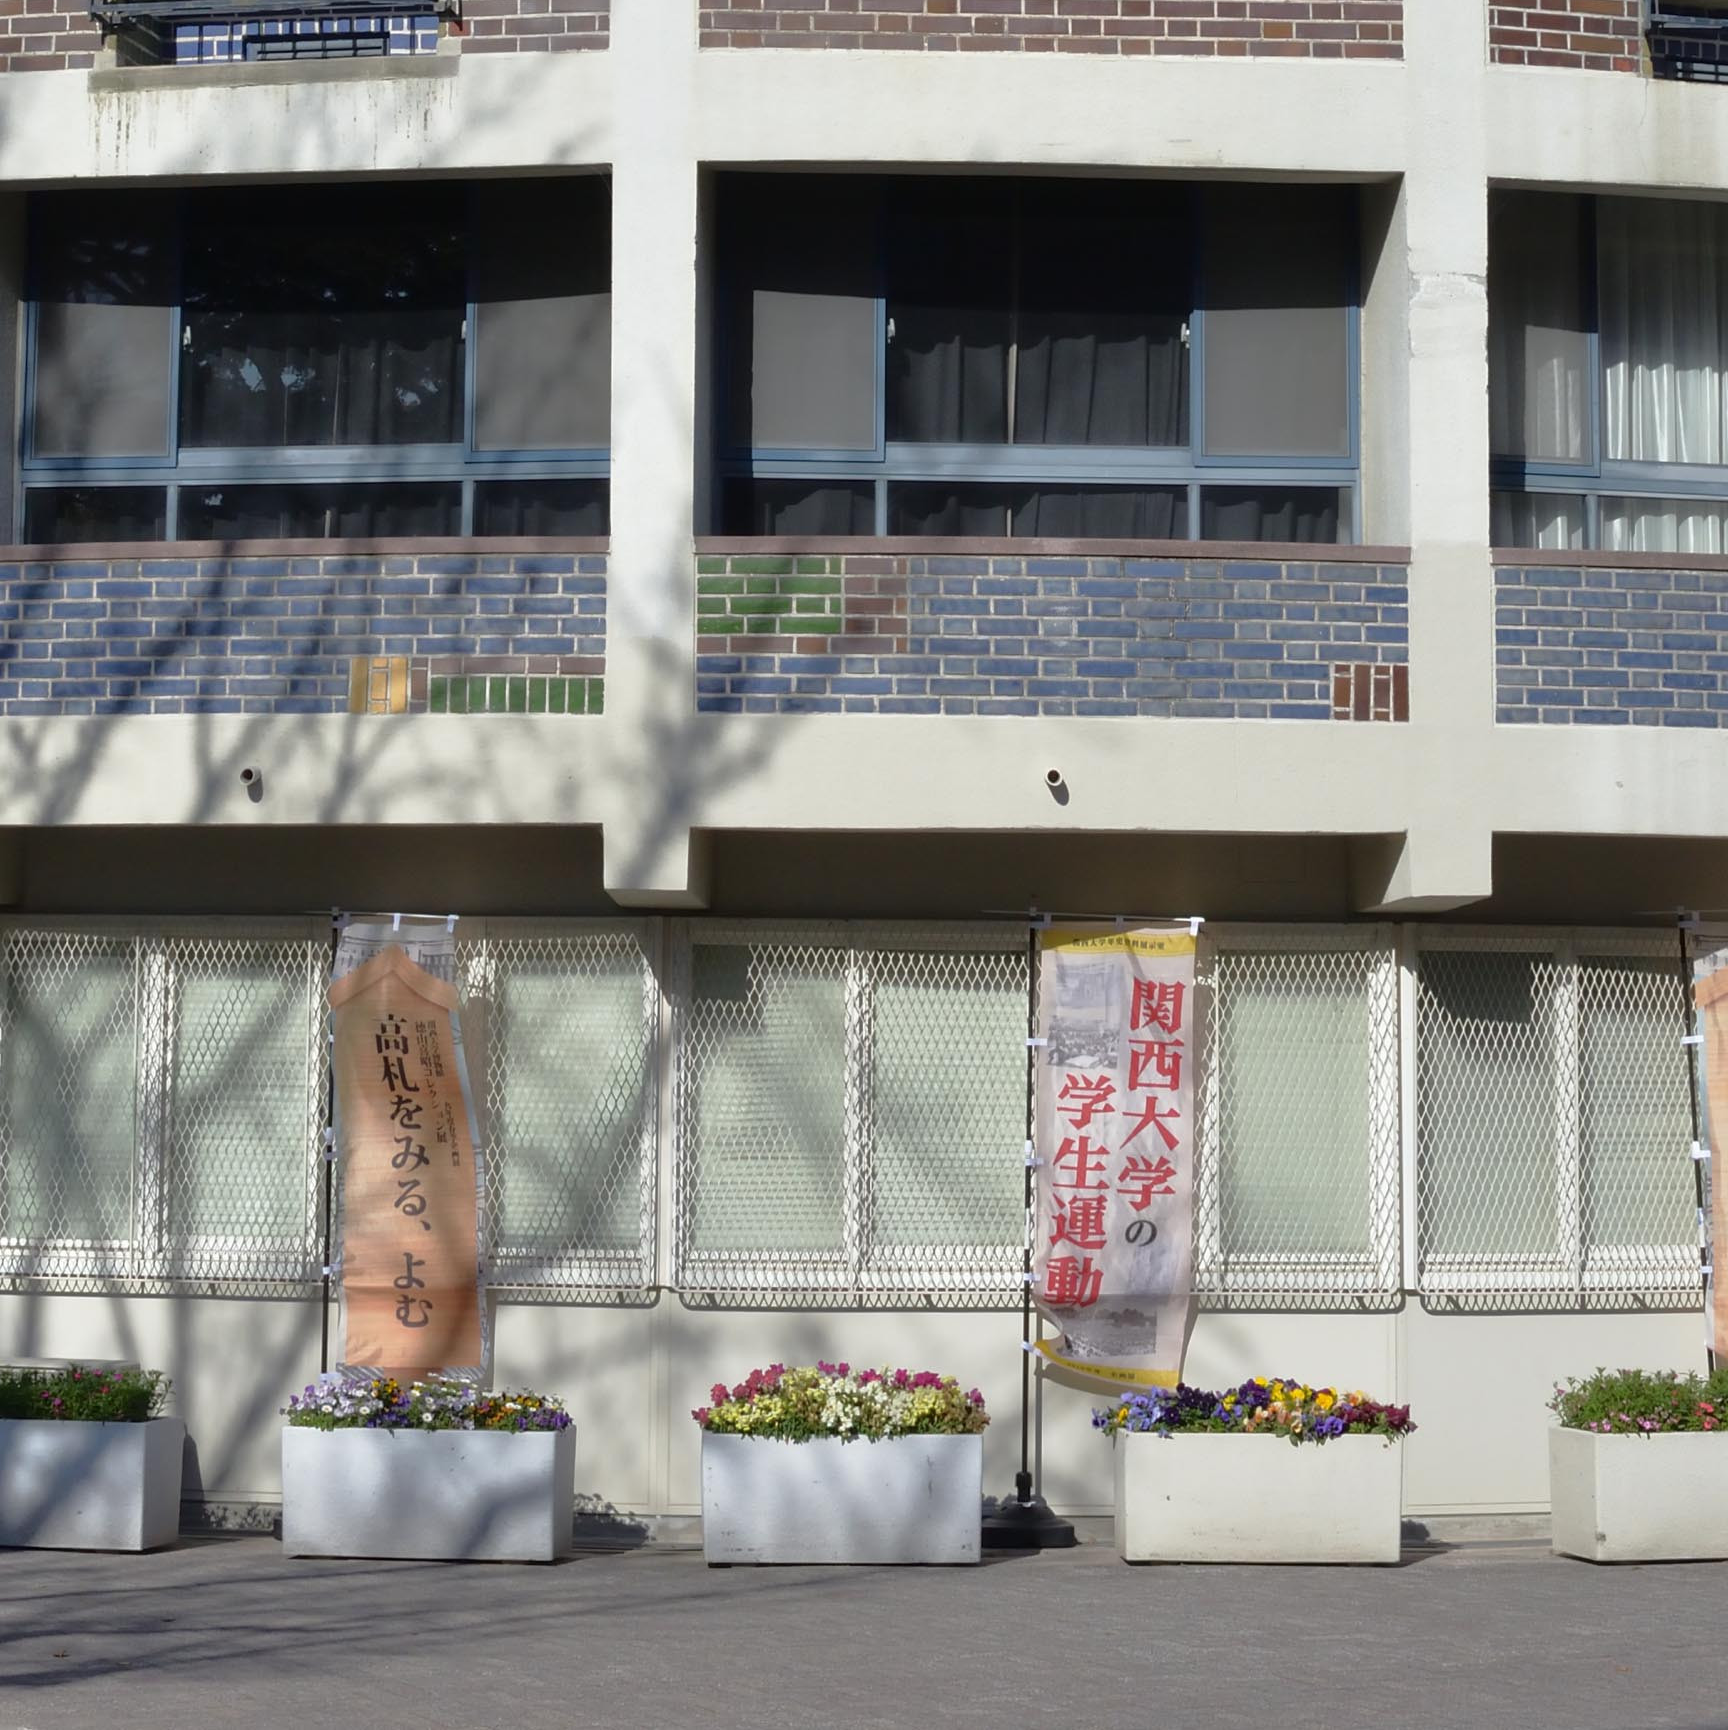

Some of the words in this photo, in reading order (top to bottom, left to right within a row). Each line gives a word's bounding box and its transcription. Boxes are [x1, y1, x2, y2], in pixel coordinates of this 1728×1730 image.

[1043, 1073, 1116, 1308] 学生運動
[1116, 976, 1187, 1248] 関西大学の
